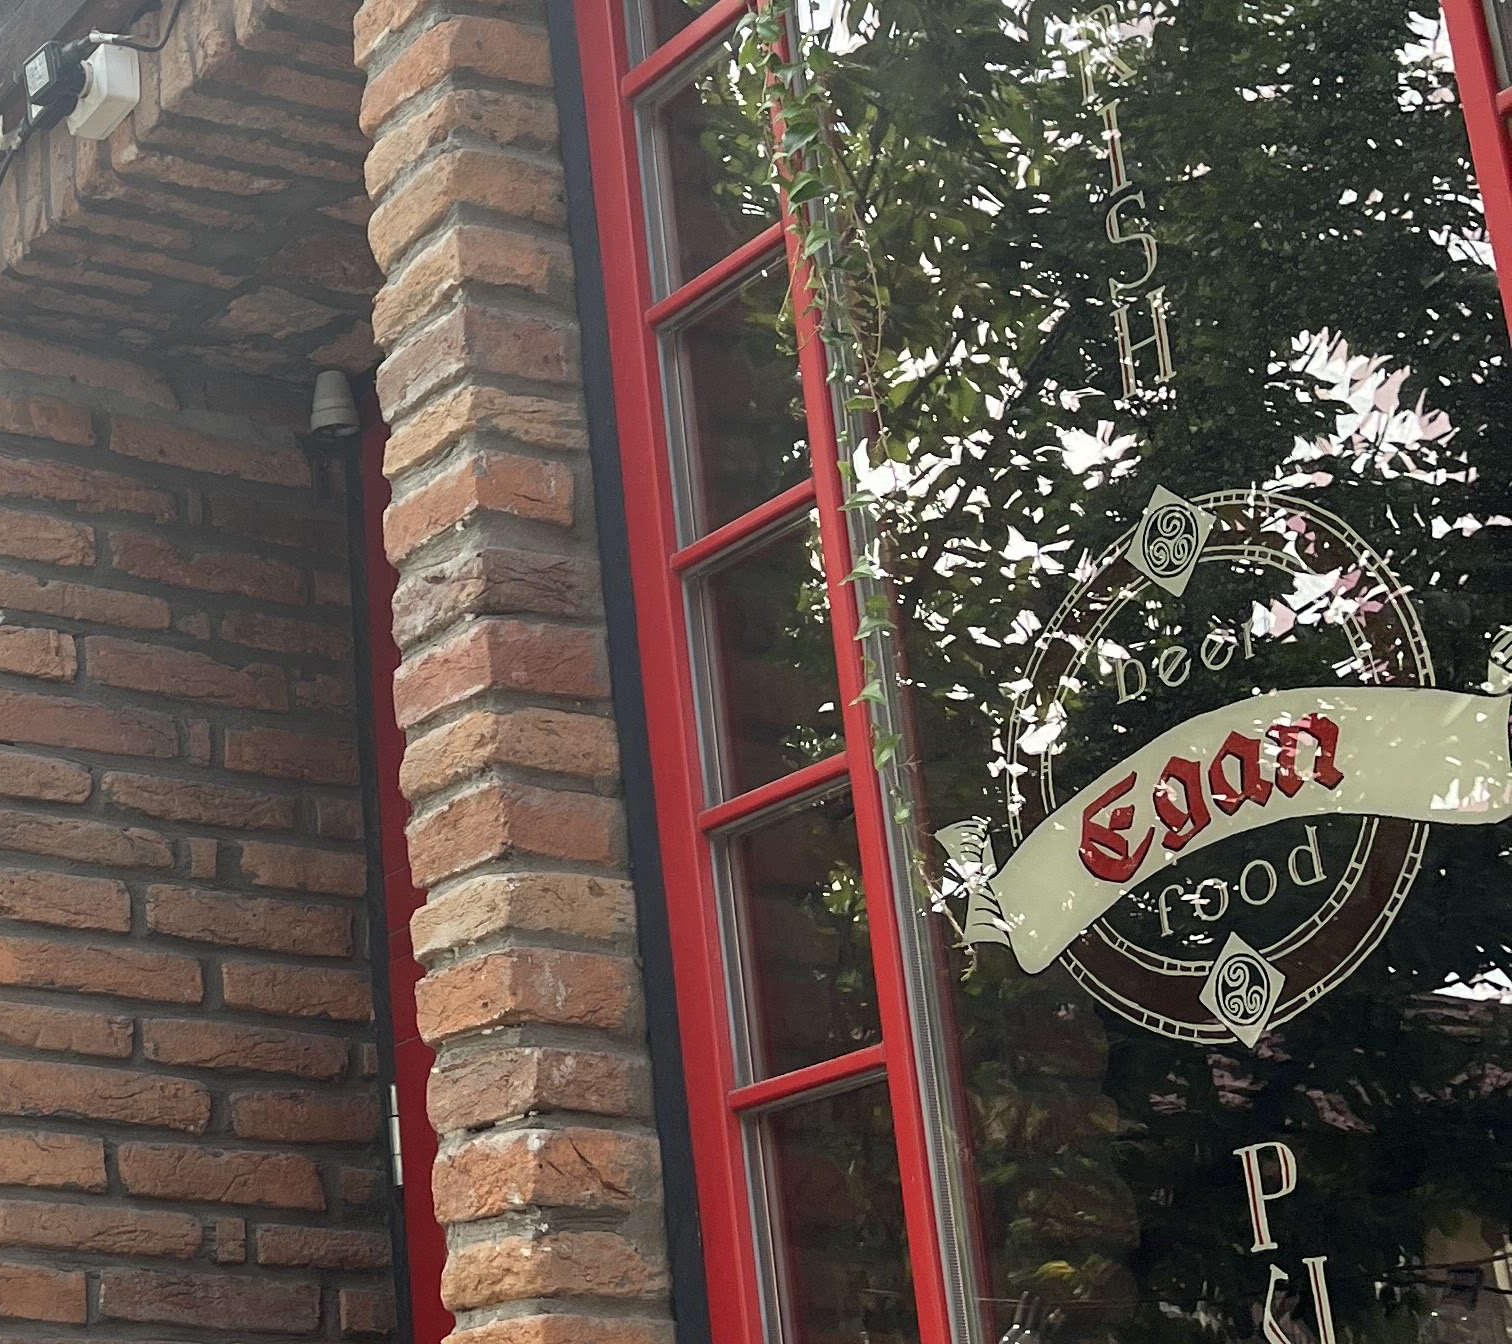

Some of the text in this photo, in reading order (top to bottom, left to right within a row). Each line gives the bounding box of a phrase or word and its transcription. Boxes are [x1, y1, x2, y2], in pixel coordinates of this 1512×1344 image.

[1115, 617, 1256, 705] beer
[1078, 712, 1344, 883] Egan
[1159, 825, 1327, 937] food
